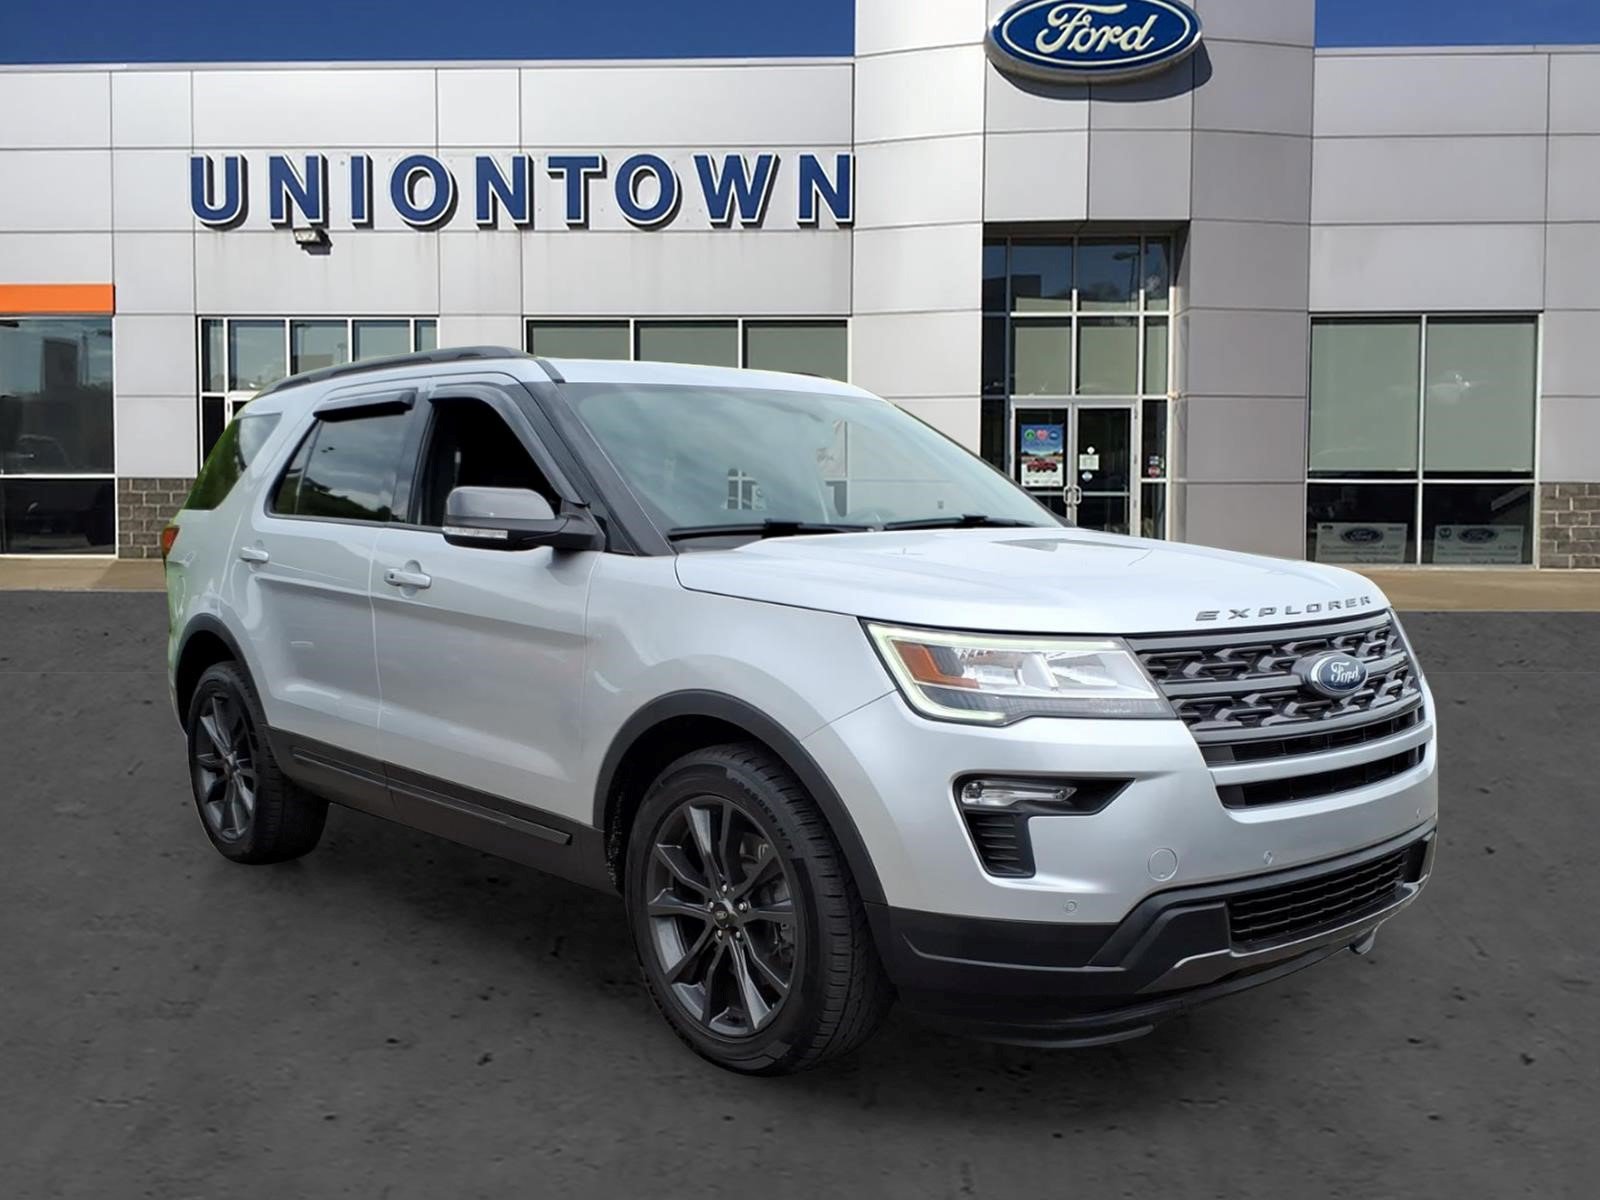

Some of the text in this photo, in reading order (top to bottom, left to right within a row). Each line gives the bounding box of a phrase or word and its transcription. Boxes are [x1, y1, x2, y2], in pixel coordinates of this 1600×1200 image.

[1035, 3, 1158, 53] Ford
[189, 153, 854, 226] UNIONTOWN
[1195, 595, 1371, 621] EXPLORER
[1331, 661, 1360, 683] Ford
